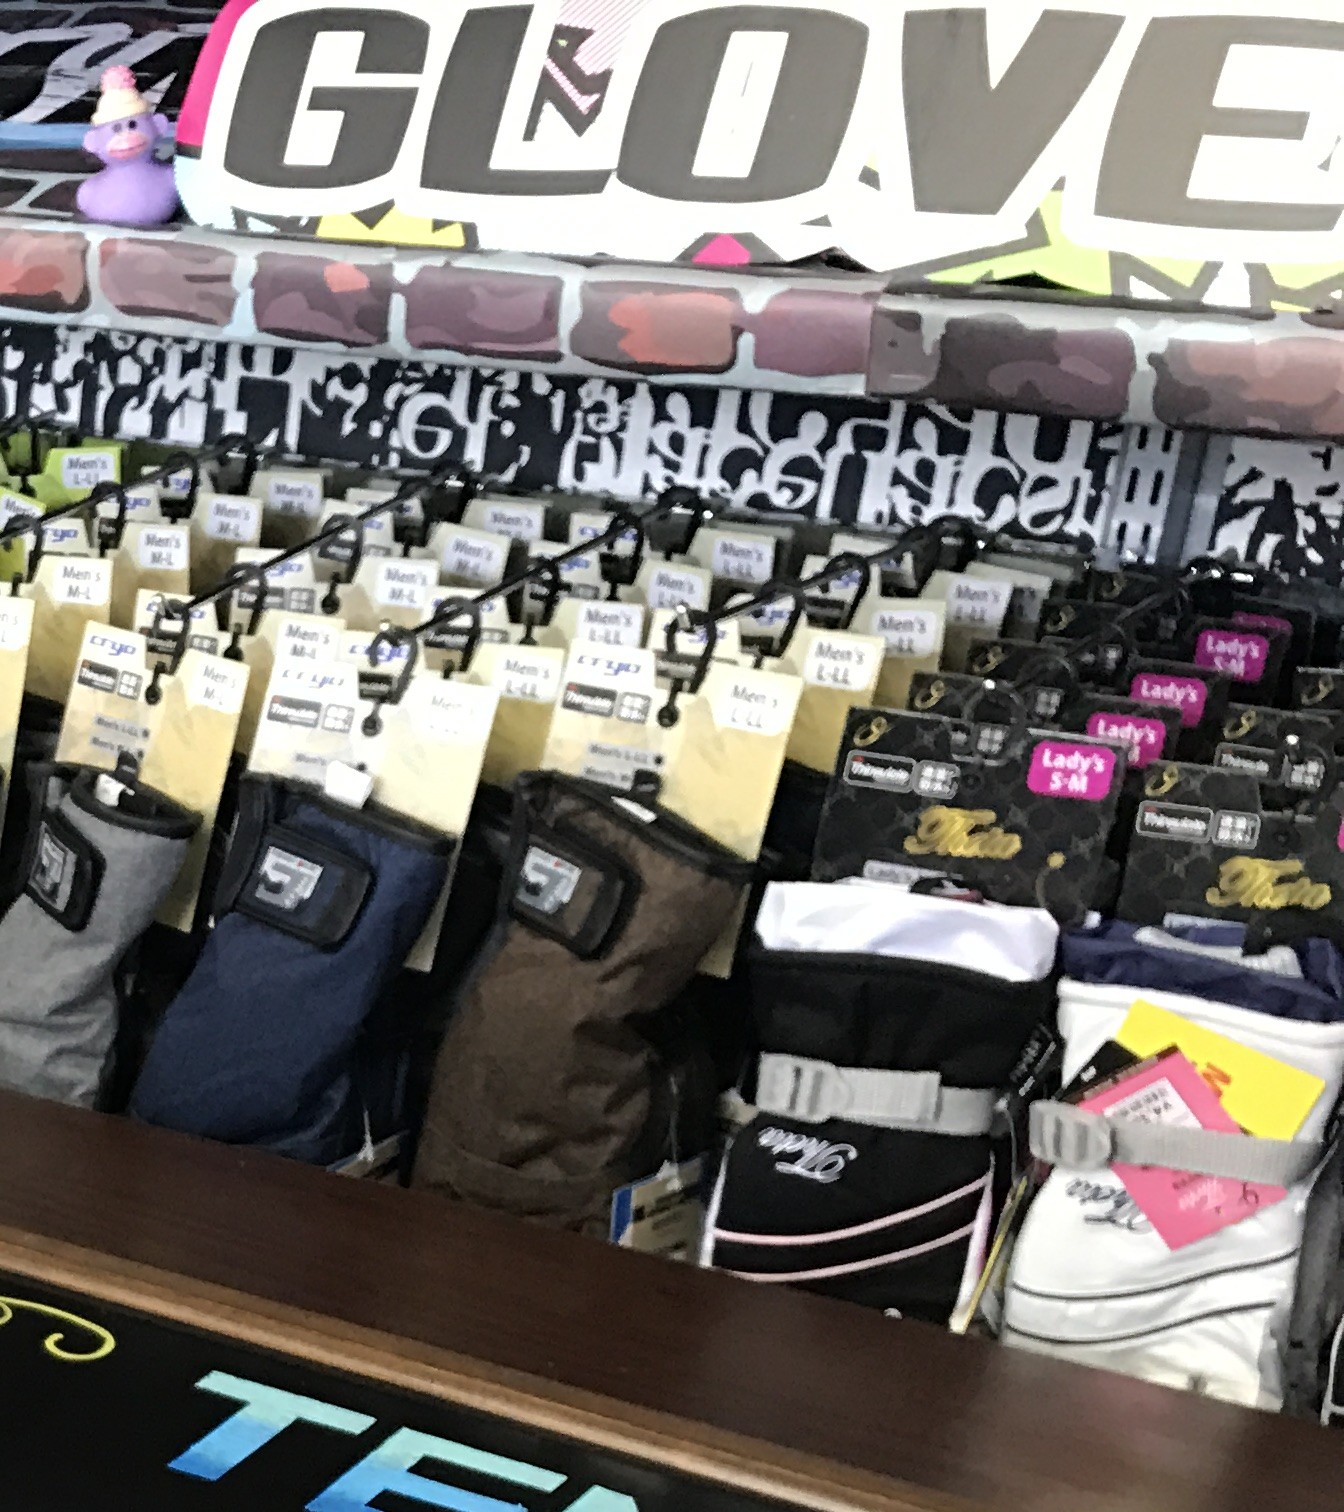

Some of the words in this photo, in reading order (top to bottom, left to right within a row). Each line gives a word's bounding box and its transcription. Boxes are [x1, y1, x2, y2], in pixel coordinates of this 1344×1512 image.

[89, 635, 137, 655] cryo
[1206, 635, 1261, 659] Lady's
[1141, 679, 1198, 704] Lady's
[1097, 719, 1156, 745] Lady's
[1042, 748, 1106, 773] Lady's
